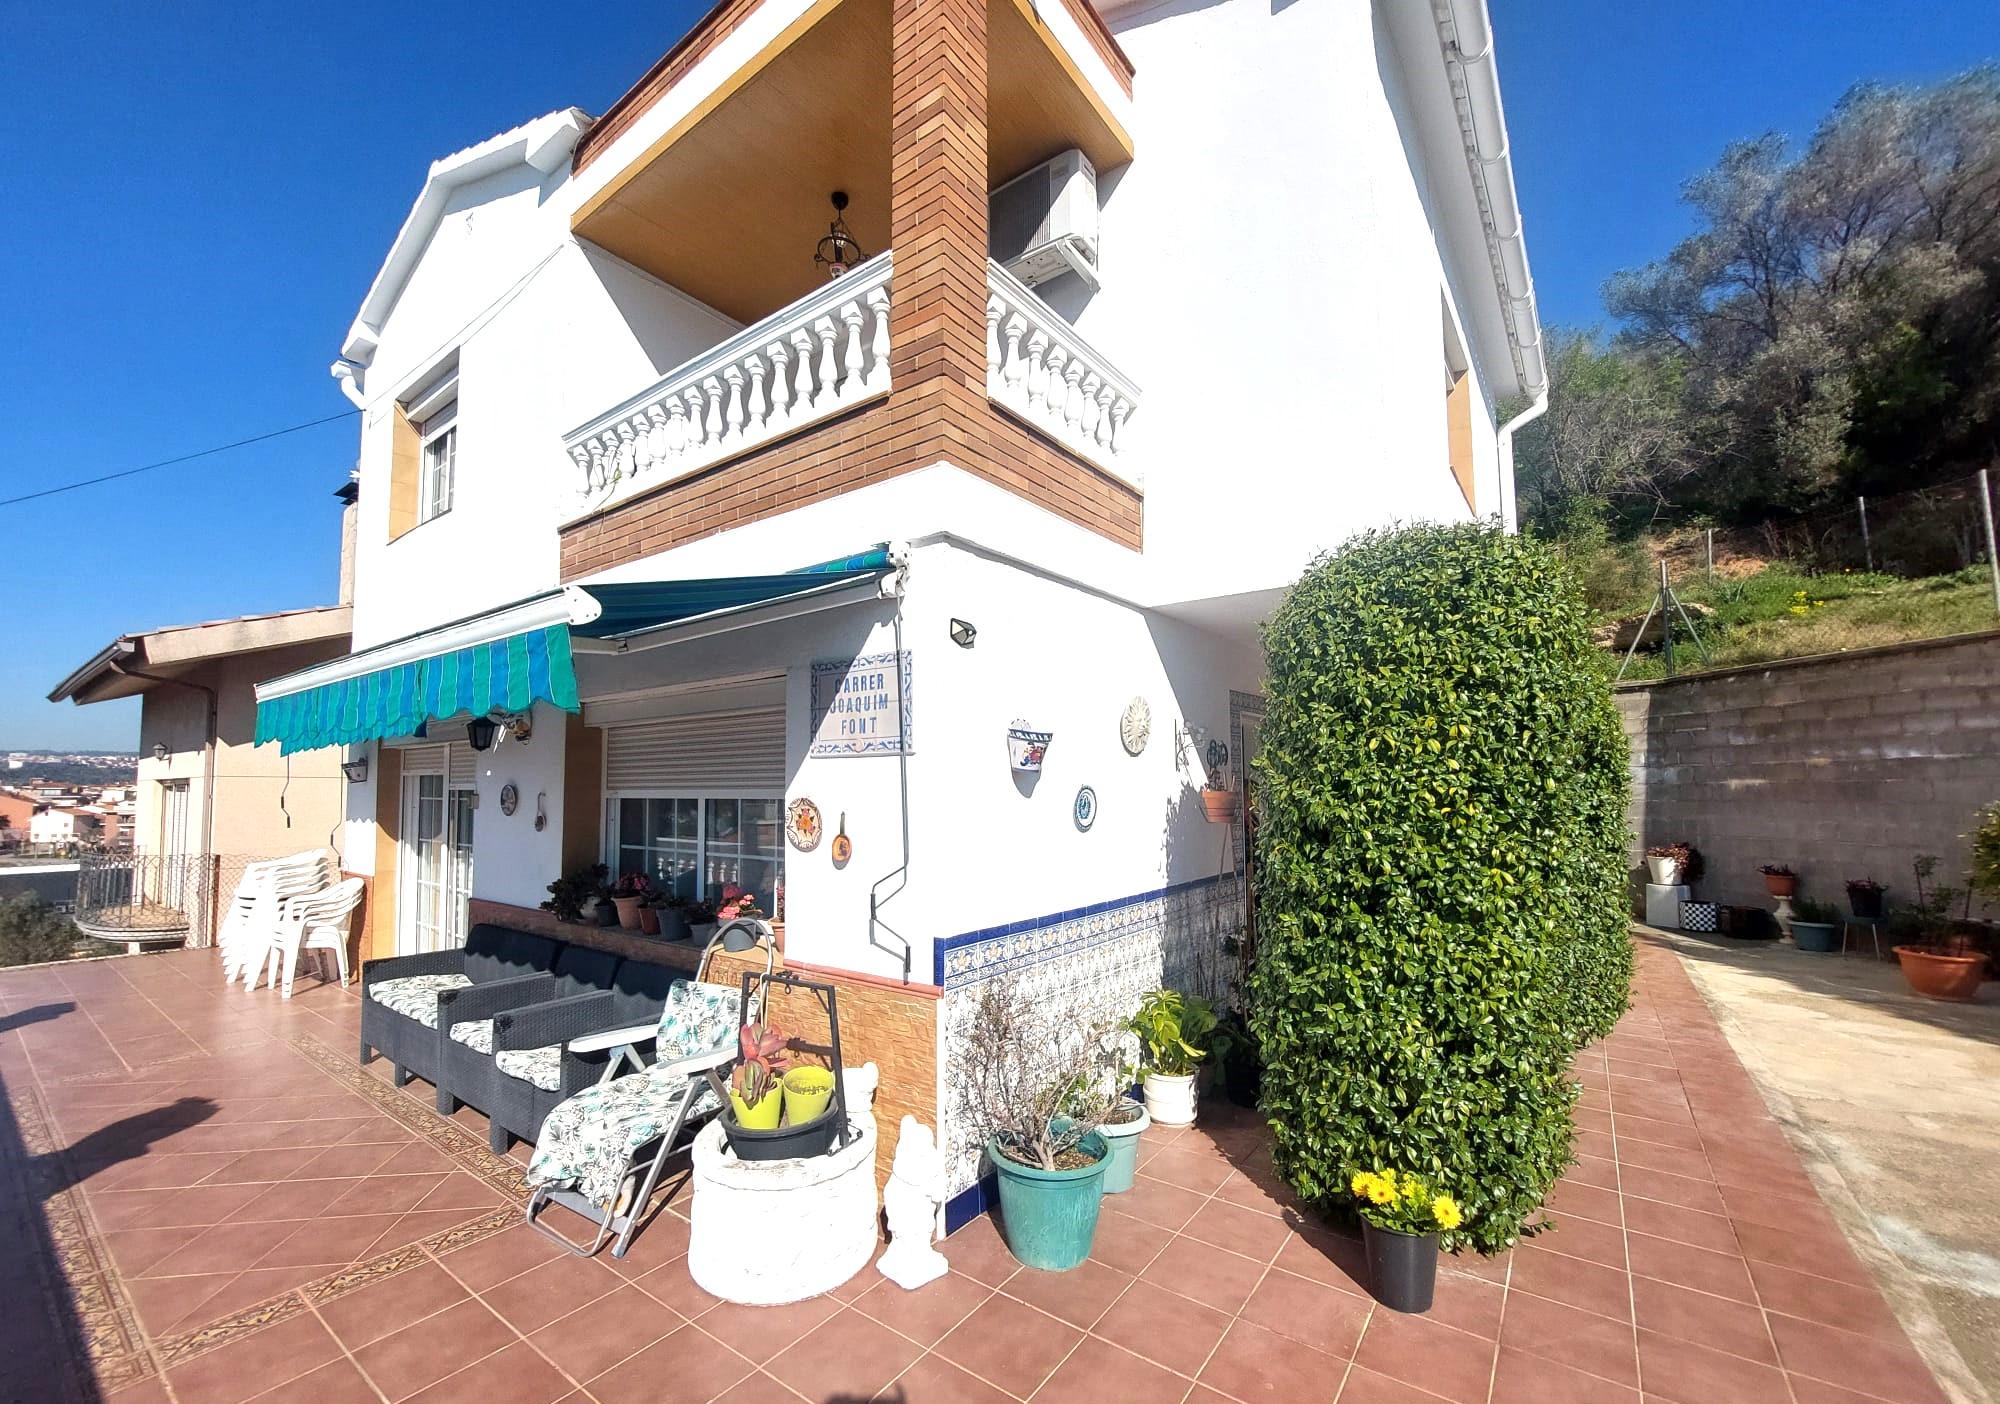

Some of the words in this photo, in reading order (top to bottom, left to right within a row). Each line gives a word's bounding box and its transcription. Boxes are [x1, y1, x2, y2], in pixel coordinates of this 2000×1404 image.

[834, 673, 884, 694] CARRER
[830, 693, 888, 714] JOAQUIM
[841, 717, 877, 735] FONT
